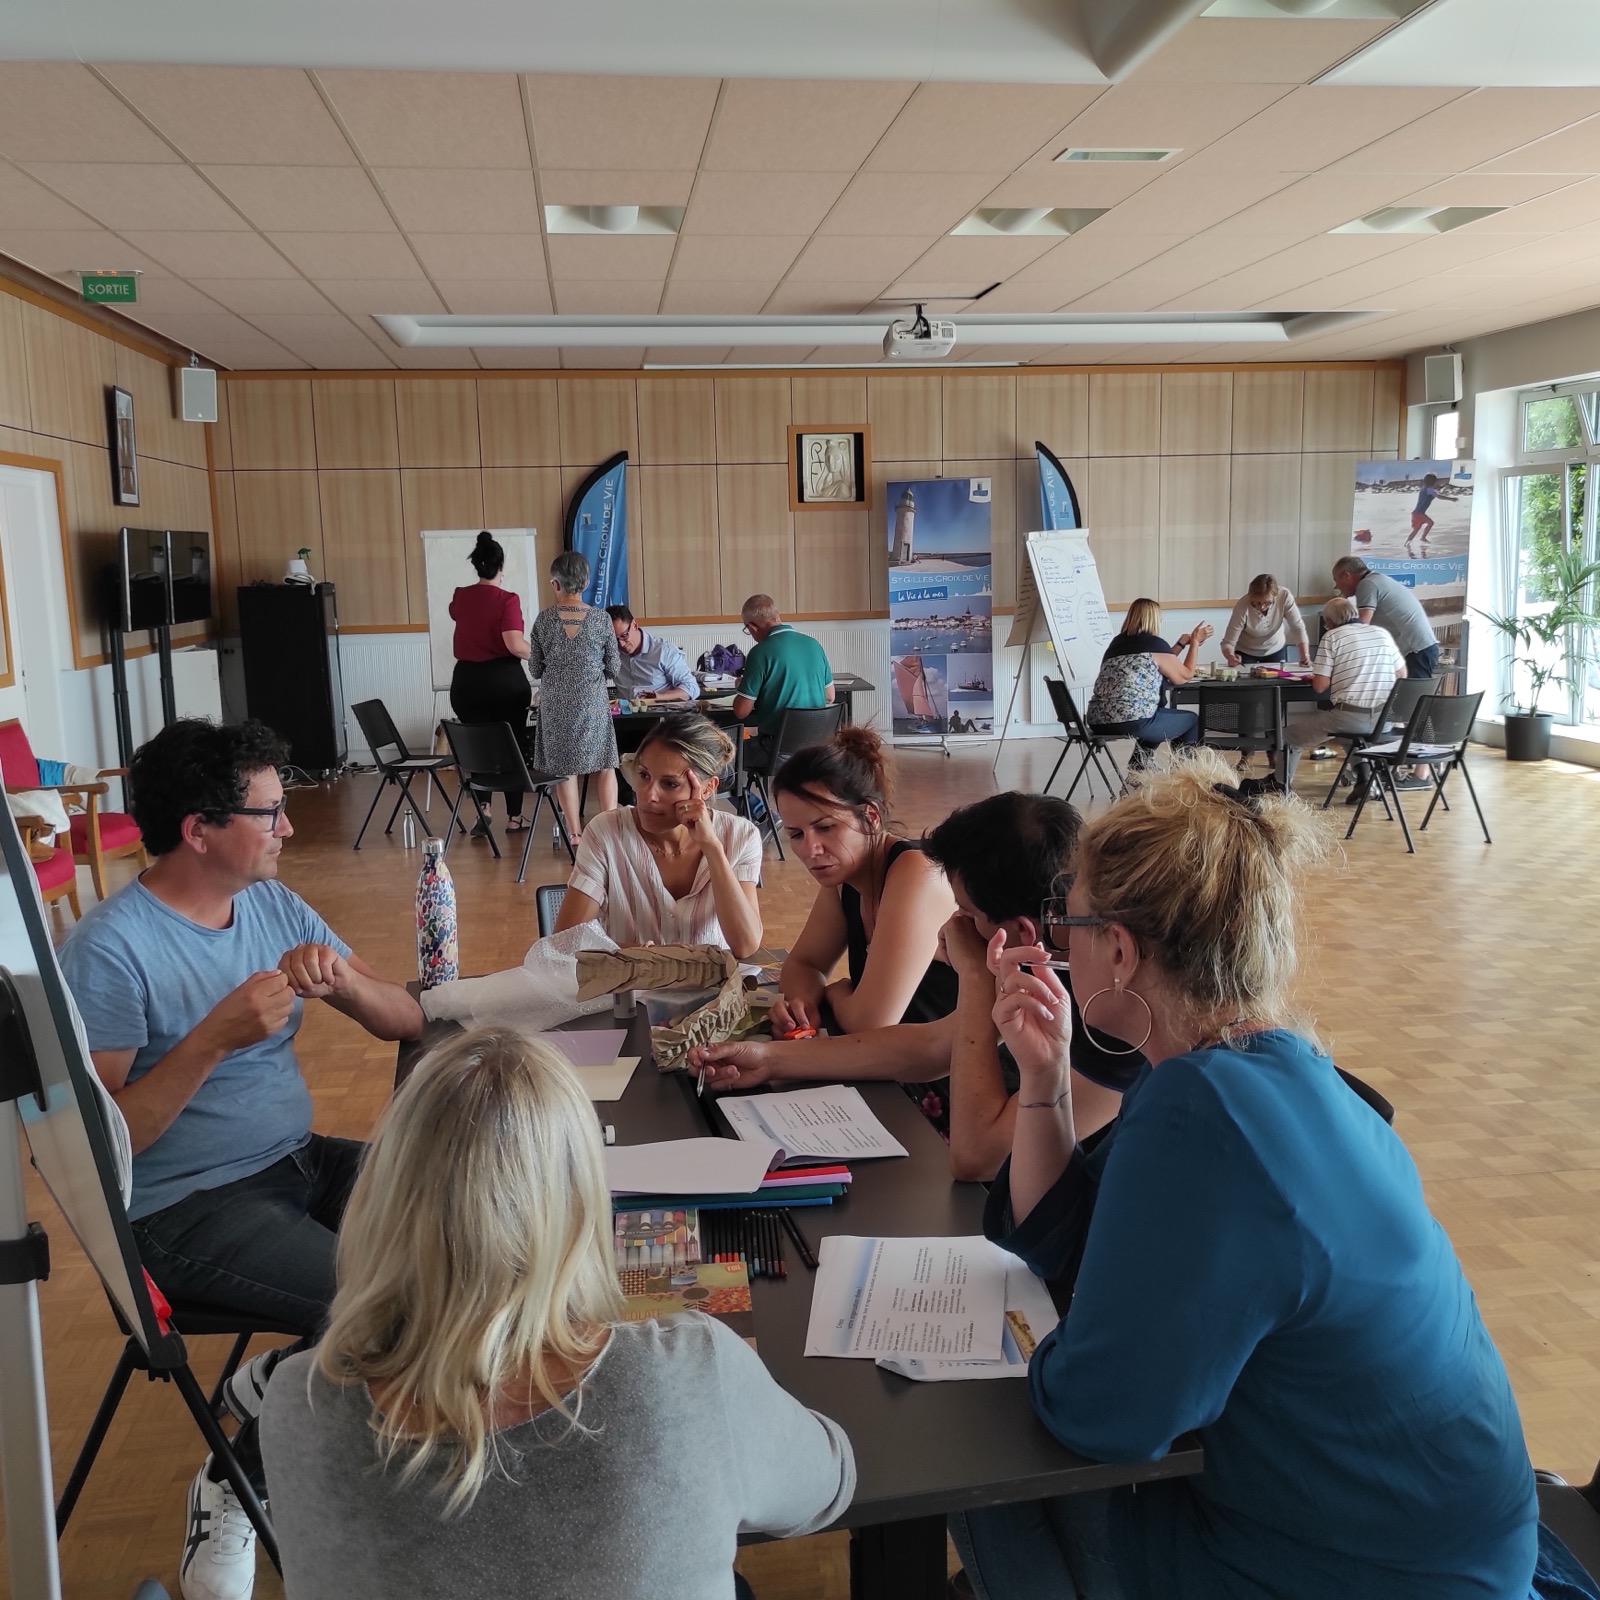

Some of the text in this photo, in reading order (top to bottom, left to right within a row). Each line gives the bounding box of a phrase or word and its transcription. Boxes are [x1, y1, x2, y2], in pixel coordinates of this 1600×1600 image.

[88, 284, 129, 295] SORTIE
[594, 479, 615, 605] GILLES CROIX DE VIE
[1367, 561, 1400, 570] GILLES
[1402, 562, 1432, 570] CROIX
[1449, 562, 1465, 571] VIE
[903, 575, 934, 584] GILLES
[935, 574, 960, 583] CROIX
[962, 574, 974, 582] DE
[975, 574, 990, 582] VIE
